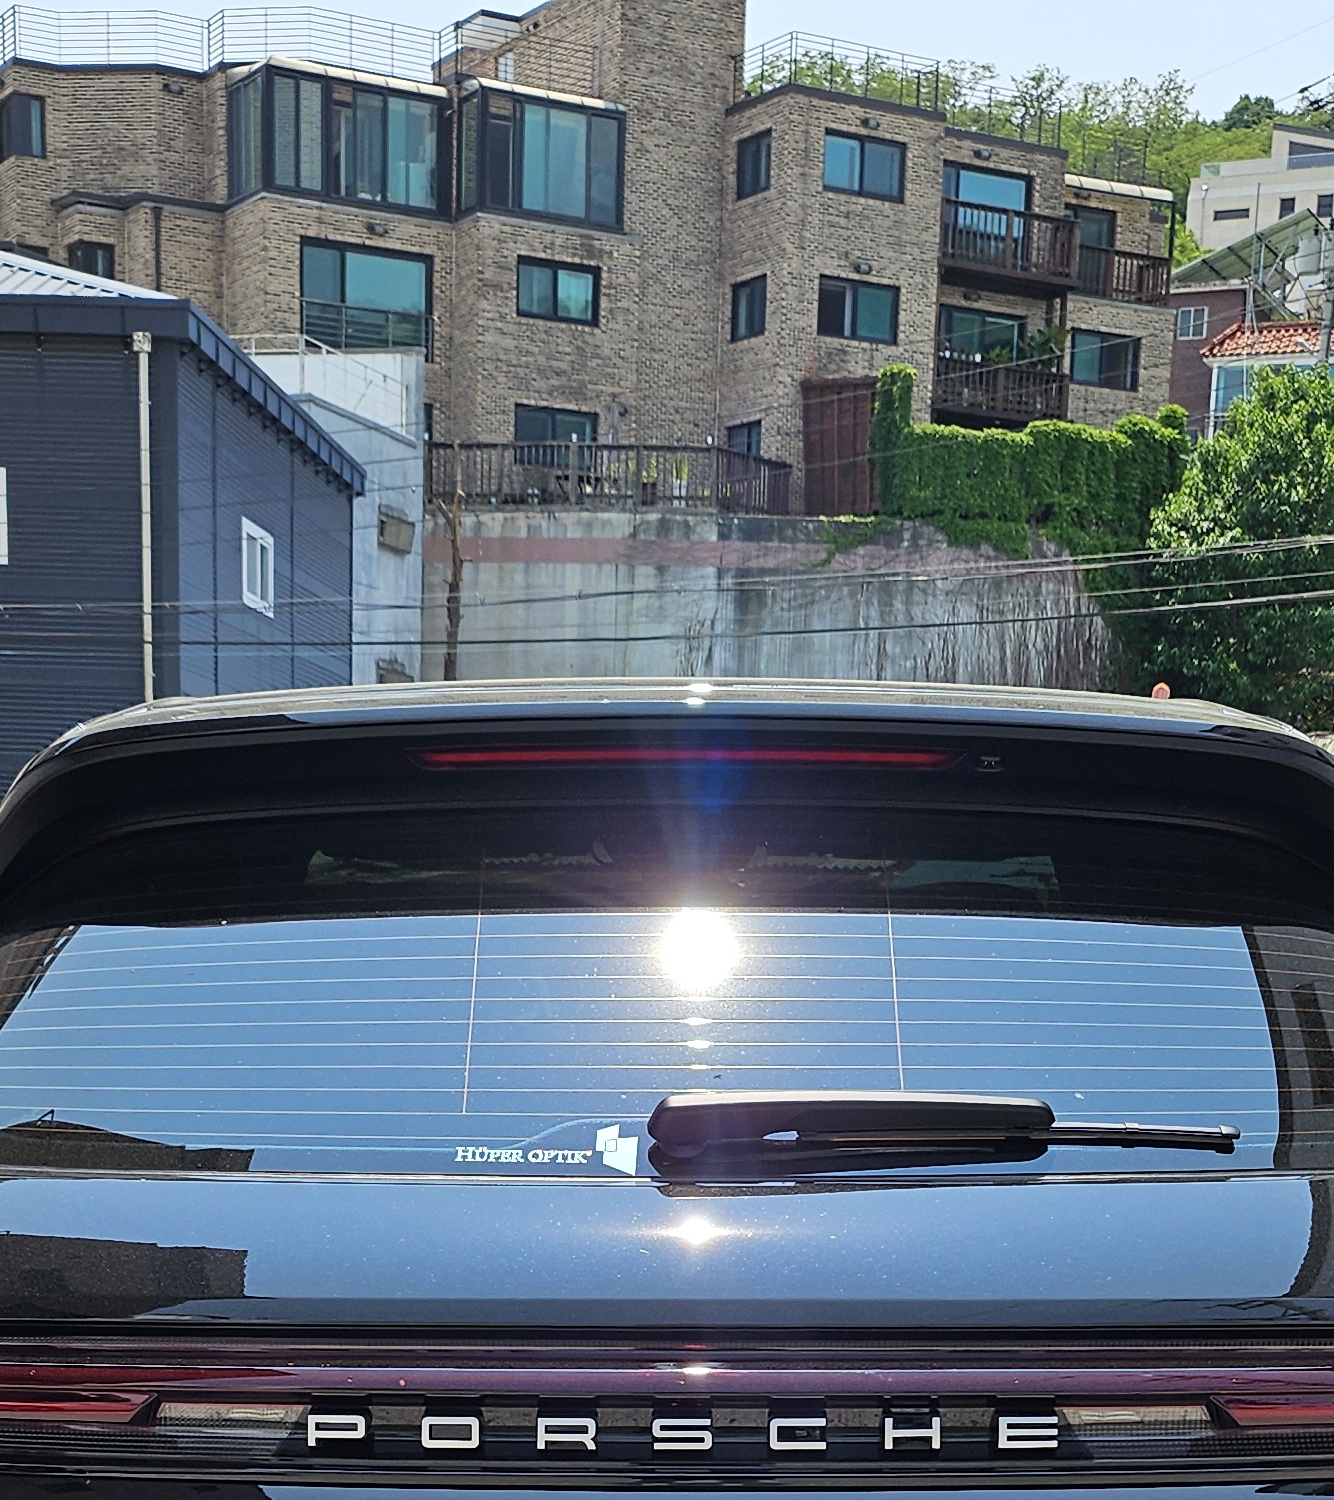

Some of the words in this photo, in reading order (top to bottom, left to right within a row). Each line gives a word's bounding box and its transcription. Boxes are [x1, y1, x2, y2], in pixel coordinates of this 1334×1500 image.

[454, 1146, 524, 1163] HÜPER
[527, 1149, 587, 1164] OPTIK
[306, 1415, 1060, 1451] PORSCHE
